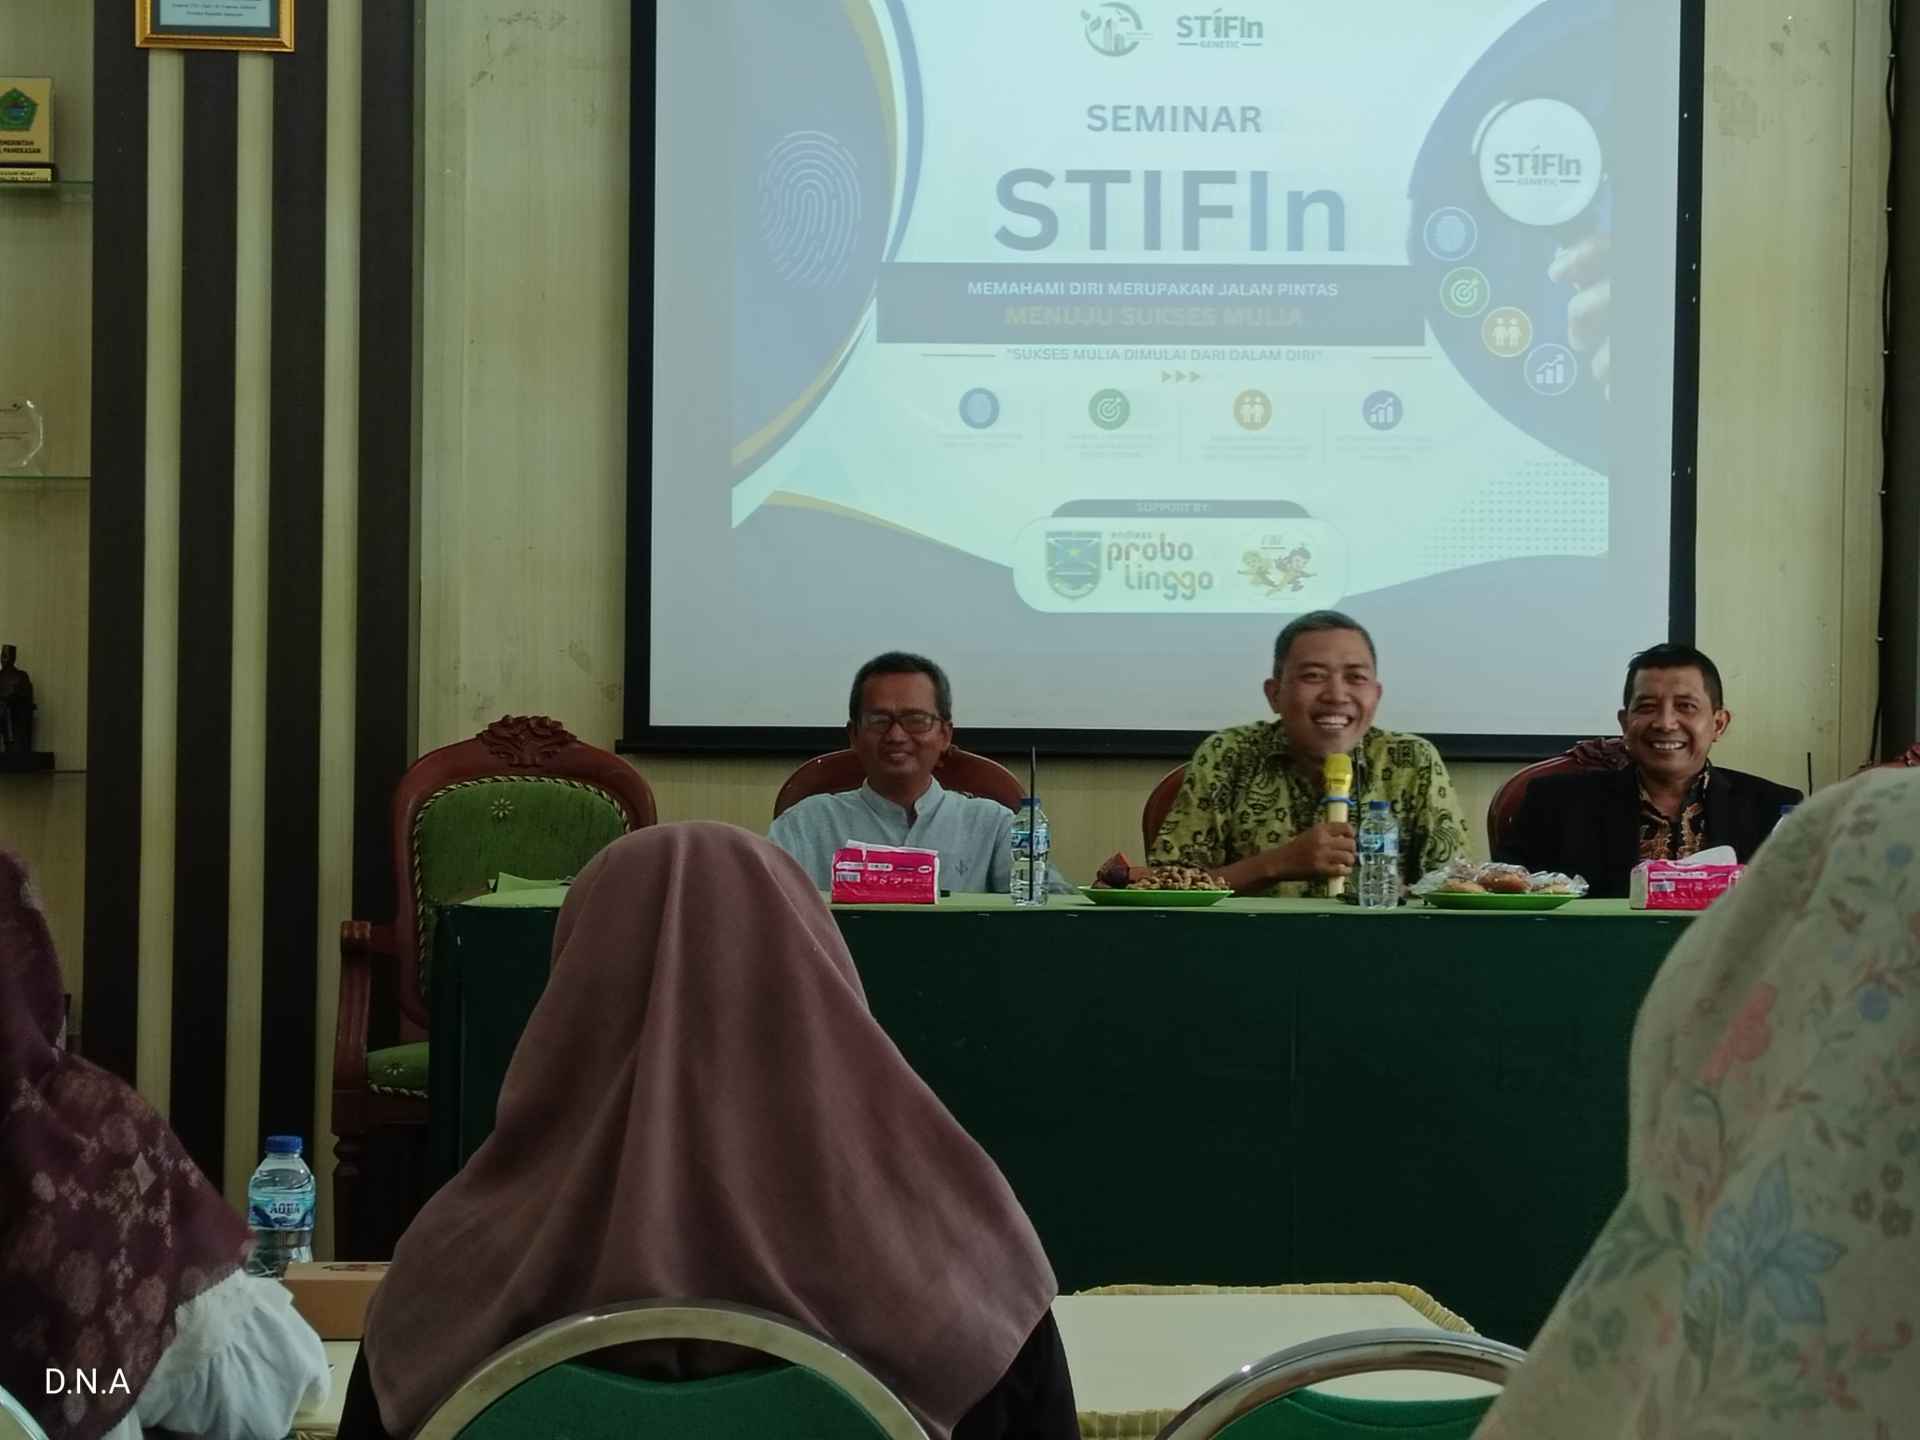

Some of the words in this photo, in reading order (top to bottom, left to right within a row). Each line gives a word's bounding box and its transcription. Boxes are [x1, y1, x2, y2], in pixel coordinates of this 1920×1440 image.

[1087, 104, 1262, 133] SEMINAR
[994, 167, 1346, 252] STIFIn
[967, 282, 1065, 296] MEMAHAMI
[1070, 282, 1103, 296] DIRI
[1108, 282, 1216, 296] MERUPAKAN
[1218, 282, 1273, 297] JALAN
[1278, 283, 1338, 297] PINTAS
[1005, 305, 1113, 327] MENUJU
[1120, 305, 1217, 328] SUKSES
[1224, 305, 1304, 328] MULIA
[1074, 348, 1121, 361] MULIA
[1124, 348, 1186, 361] DIMULAI
[1190, 348, 1225, 361] DARI
[1230, 348, 1282, 361] DALAM
[1136, 503, 1191, 513] SUPPORT
[1107, 532, 1194, 571] probo
[1124, 563, 1214, 601] linggo
